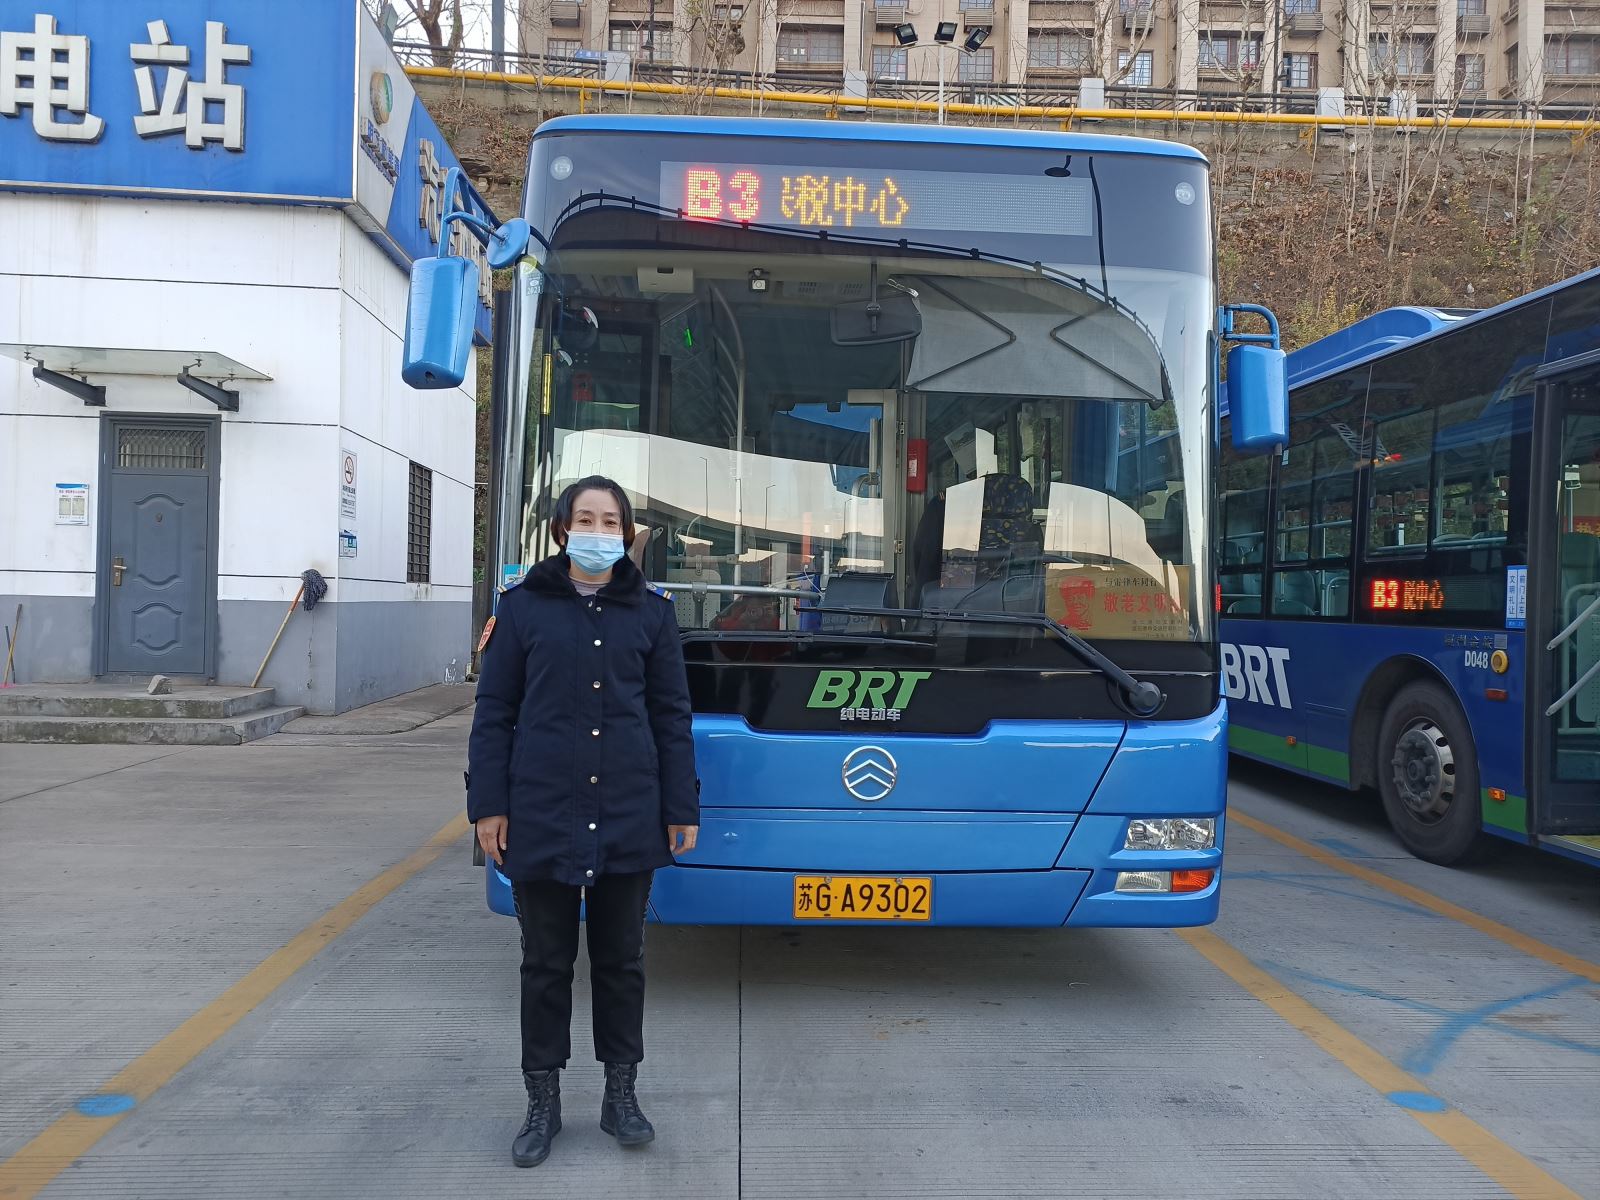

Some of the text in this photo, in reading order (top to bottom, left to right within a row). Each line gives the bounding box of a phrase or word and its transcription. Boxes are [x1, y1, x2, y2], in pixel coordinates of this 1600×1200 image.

[0, 13, 252, 152] 电站
[687, 168, 762, 220] B3
[1373, 580, 1399, 608] B3
[1220, 642, 1293, 709] BRT
[1464, 650, 1489, 669] D048
[806, 670, 932, 709] BRT
[840, 707, 901, 721] 纯电动车
